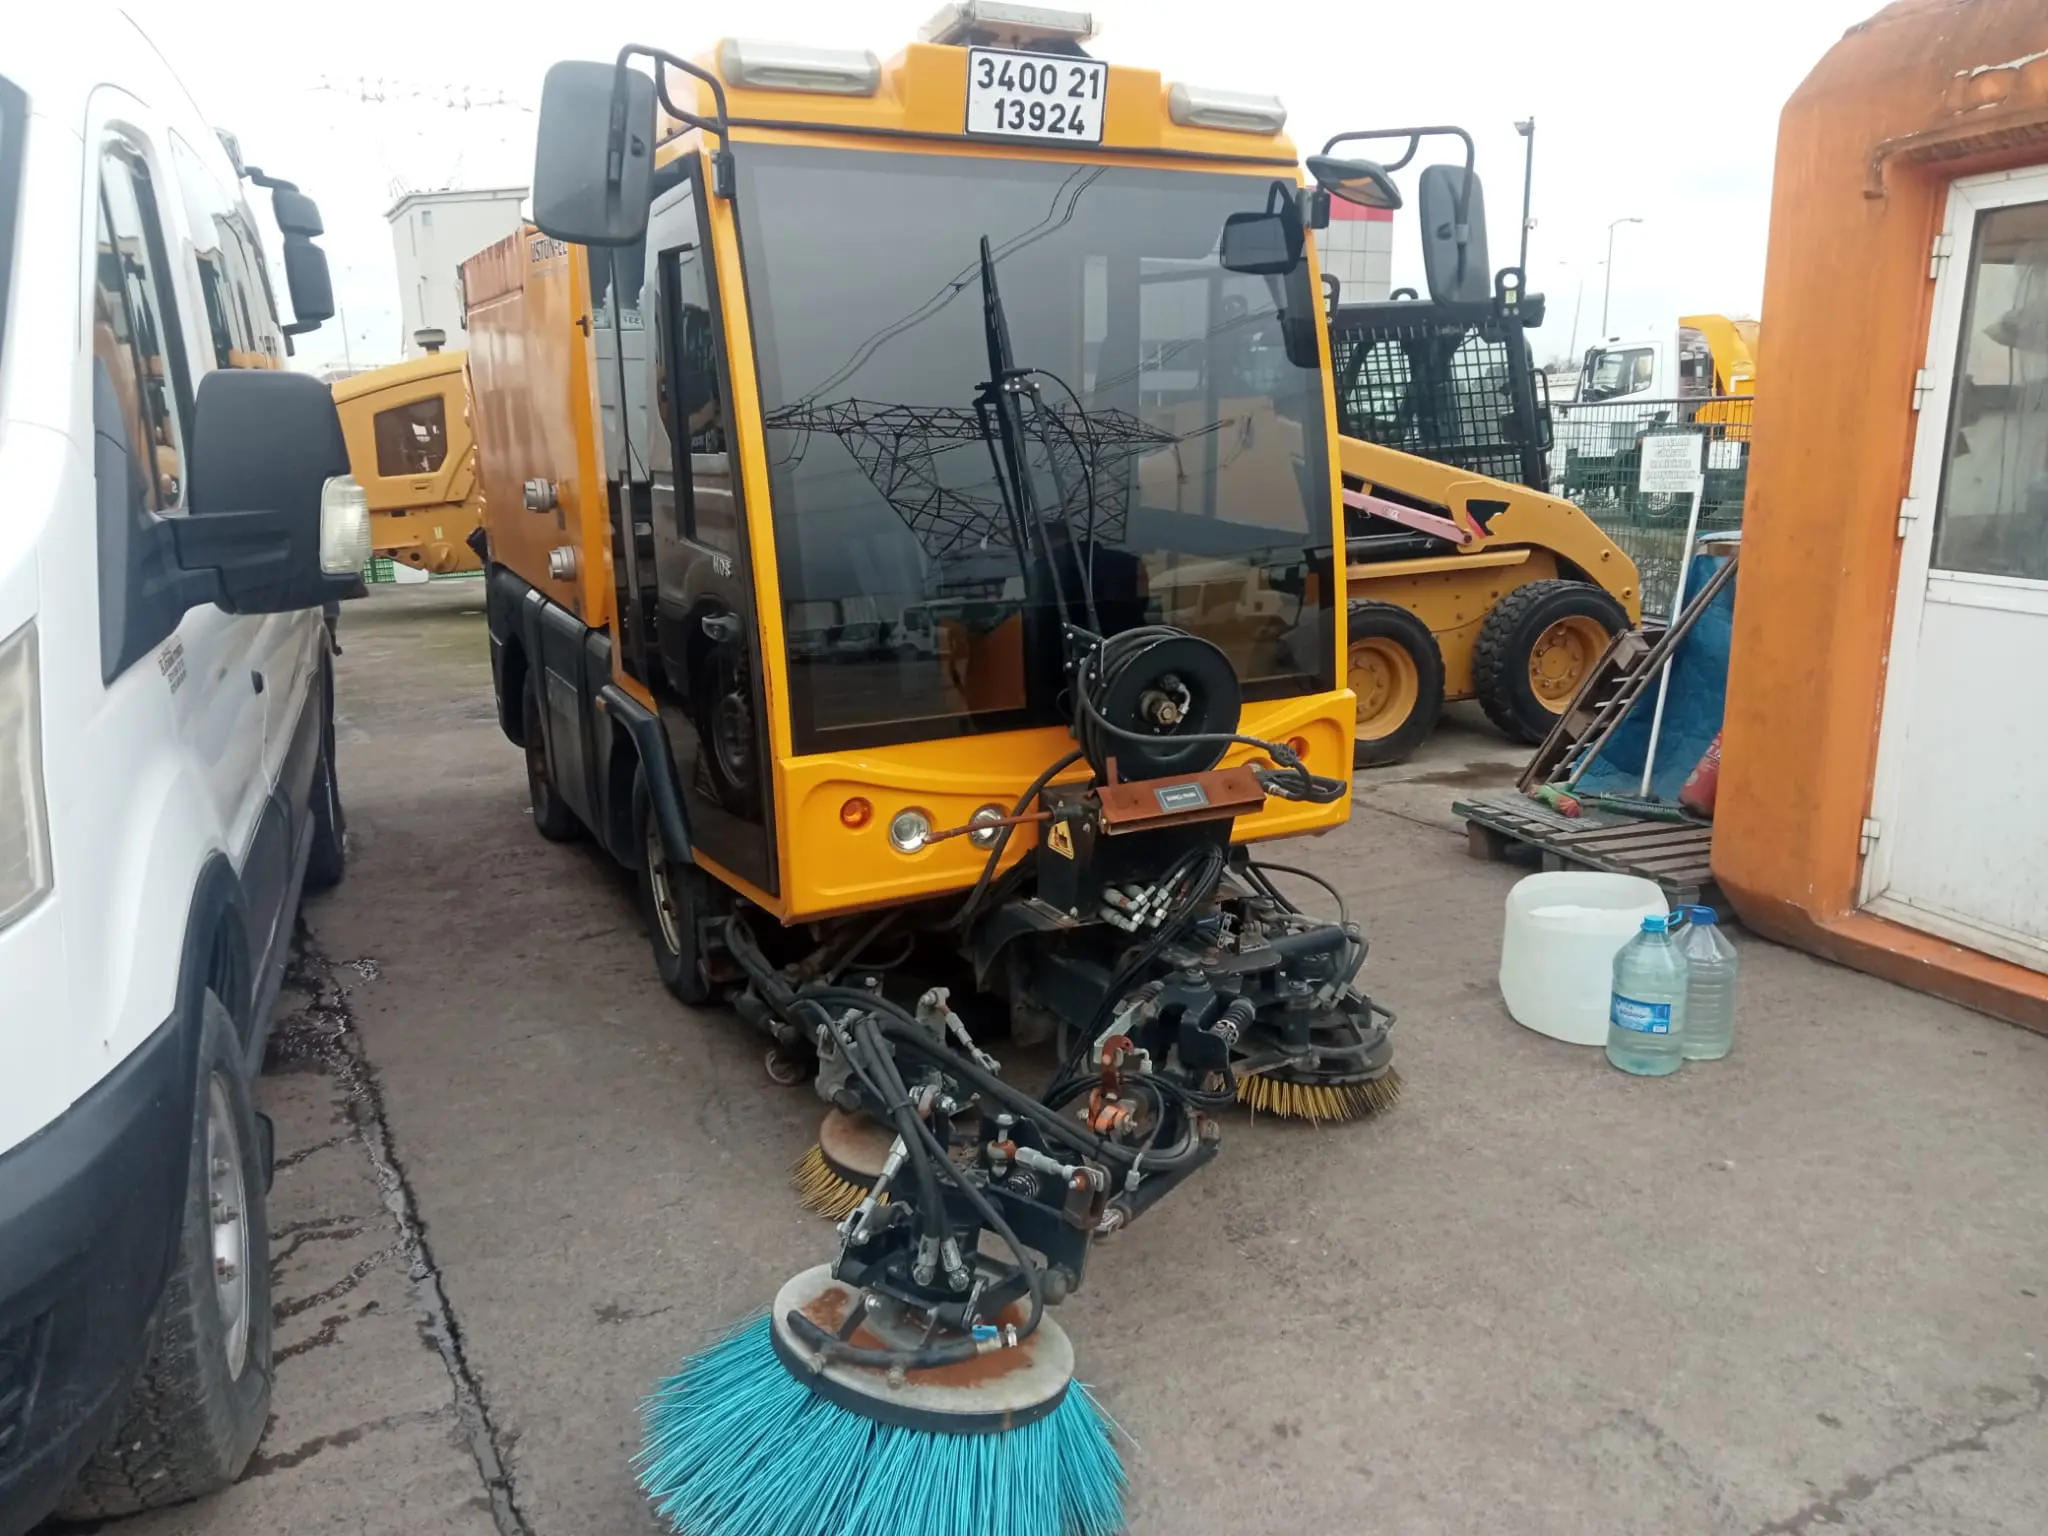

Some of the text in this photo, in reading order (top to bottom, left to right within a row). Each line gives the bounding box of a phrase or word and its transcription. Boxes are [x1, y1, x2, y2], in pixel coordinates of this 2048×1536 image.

[977, 57, 1100, 100] 3400 21
[994, 97, 1086, 135] 13924
